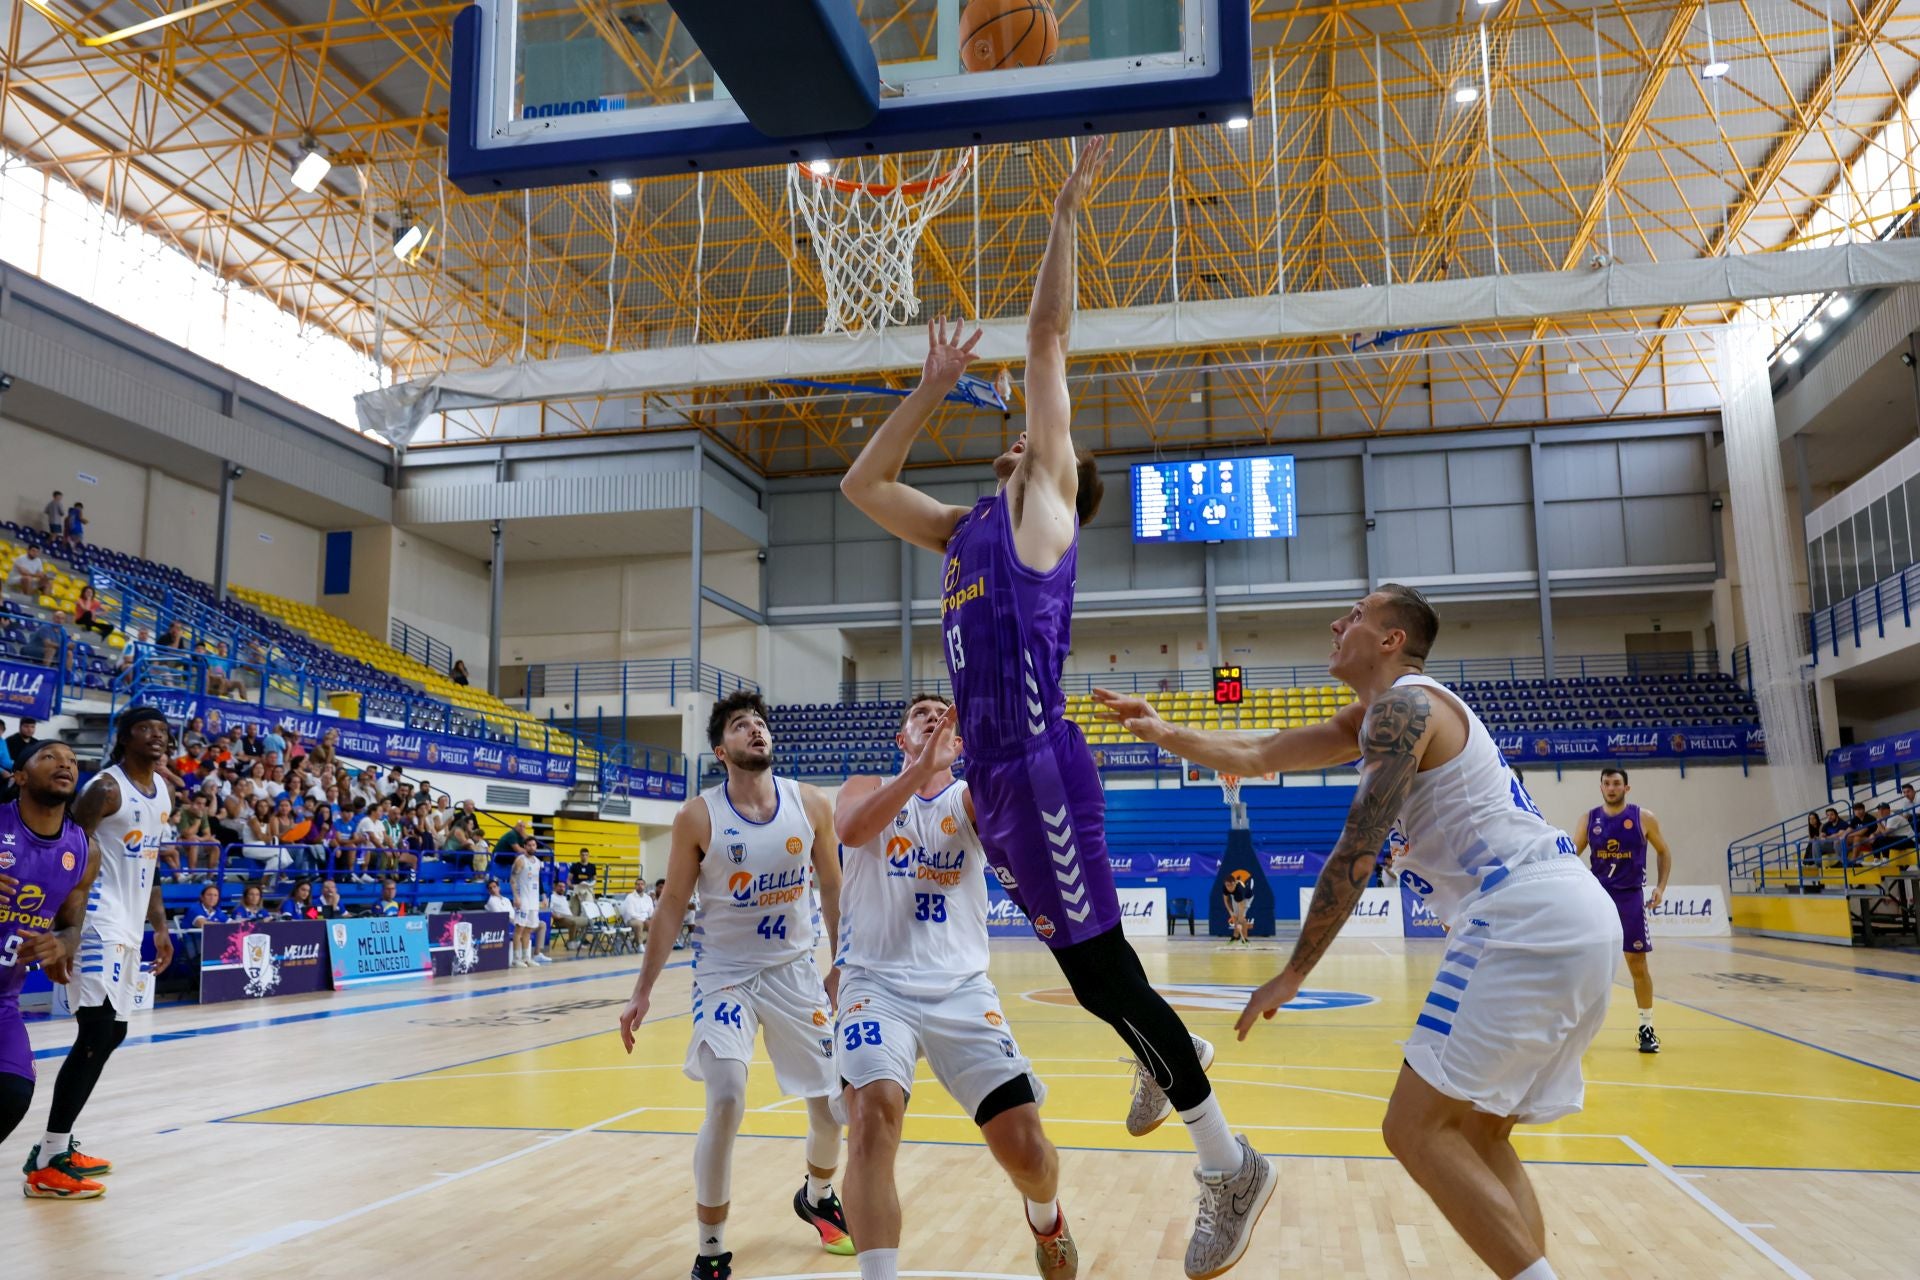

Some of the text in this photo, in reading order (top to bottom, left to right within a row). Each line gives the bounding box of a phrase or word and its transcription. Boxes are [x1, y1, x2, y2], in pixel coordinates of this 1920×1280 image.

[947, 624, 965, 674] 13
[1220, 668, 1239, 678] 4:10
[0, 670, 44, 694] LILLA
[1216, 682, 1240, 701] 20
[386, 733, 421, 752] MELILLA
[1498, 736, 1522, 749] ILLA
[1607, 732, 1658, 746] MELILLA
[1690, 739, 1737, 749] MELILLA
[1746, 729, 1766, 742] ME
[343, 737, 380, 754] MELILLA
[1555, 743, 1599, 753] MELILLA
[440, 752, 468, 765] MELILLA
[1110, 755, 1150, 764] MELILLA
[1157, 856, 1190, 868] MELILLA
[1269, 854, 1304, 865] MELILLA
[1607, 864, 1617, 878] 7
[914, 892, 947, 923] 33
[986, 898, 1025, 918] MEL
[1120, 901, 1153, 917] ILLA
[1354, 900, 1389, 917] ILLA
[1649, 899, 1711, 917] ELILLA
[0, 910, 54, 929] gropal
[370, 921, 390, 934] CLUB
[757, 914, 787, 940] 44
[480, 929, 505, 943] MELILLA
[283, 943, 320, 960] MELILLA
[358, 935, 406, 956] MELILLA
[358, 956, 410, 973] BALONCESTO
[714, 1002, 742, 1029] 44
[844, 1021, 882, 1051] 33
